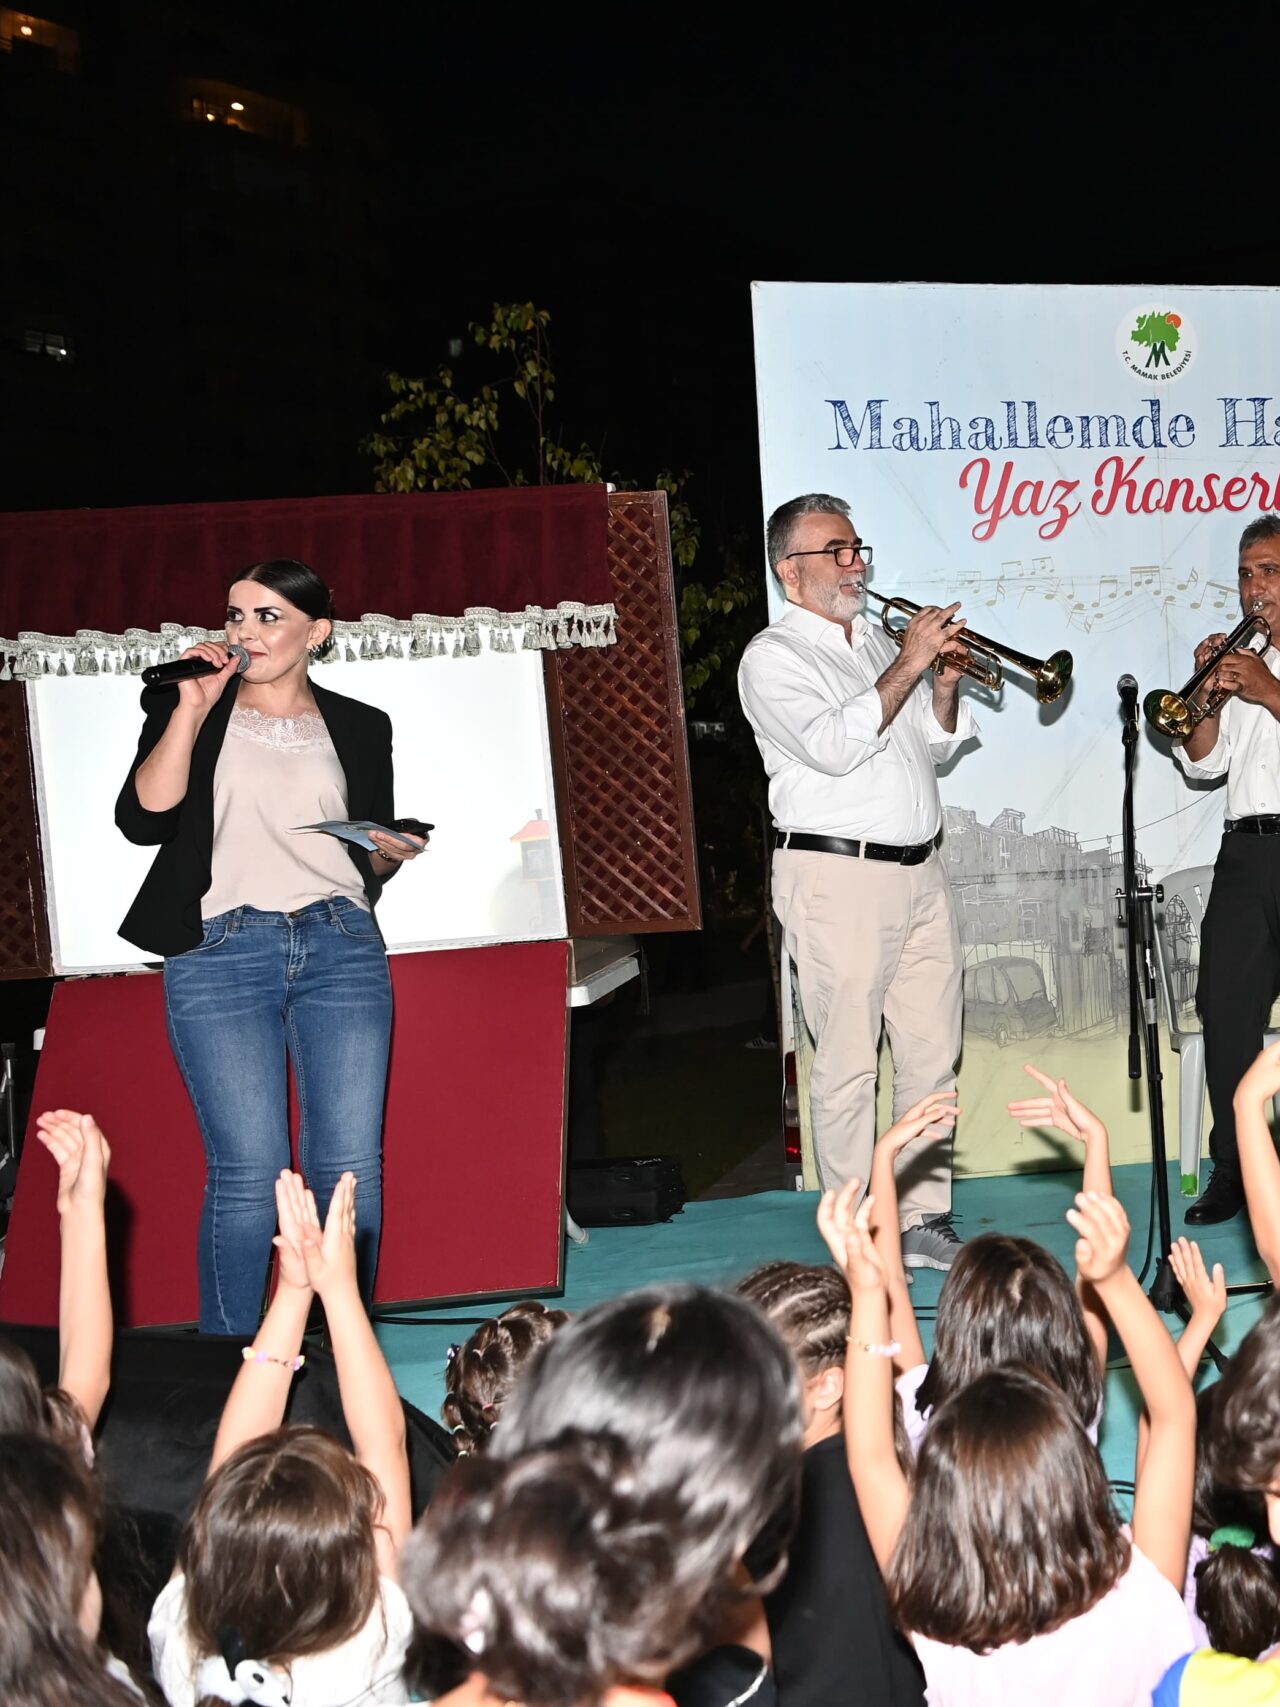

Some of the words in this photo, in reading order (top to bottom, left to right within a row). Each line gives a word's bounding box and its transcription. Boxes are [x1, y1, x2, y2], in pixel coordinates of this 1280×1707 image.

[1122, 350, 1131, 364] T.C.
[1130, 364, 1159, 380] MAMAK
[1160, 350, 1192, 380] BELEDİYESİ
[825, 399, 1195, 451] Mahallemde
[958, 456, 1082, 541] Yaz
